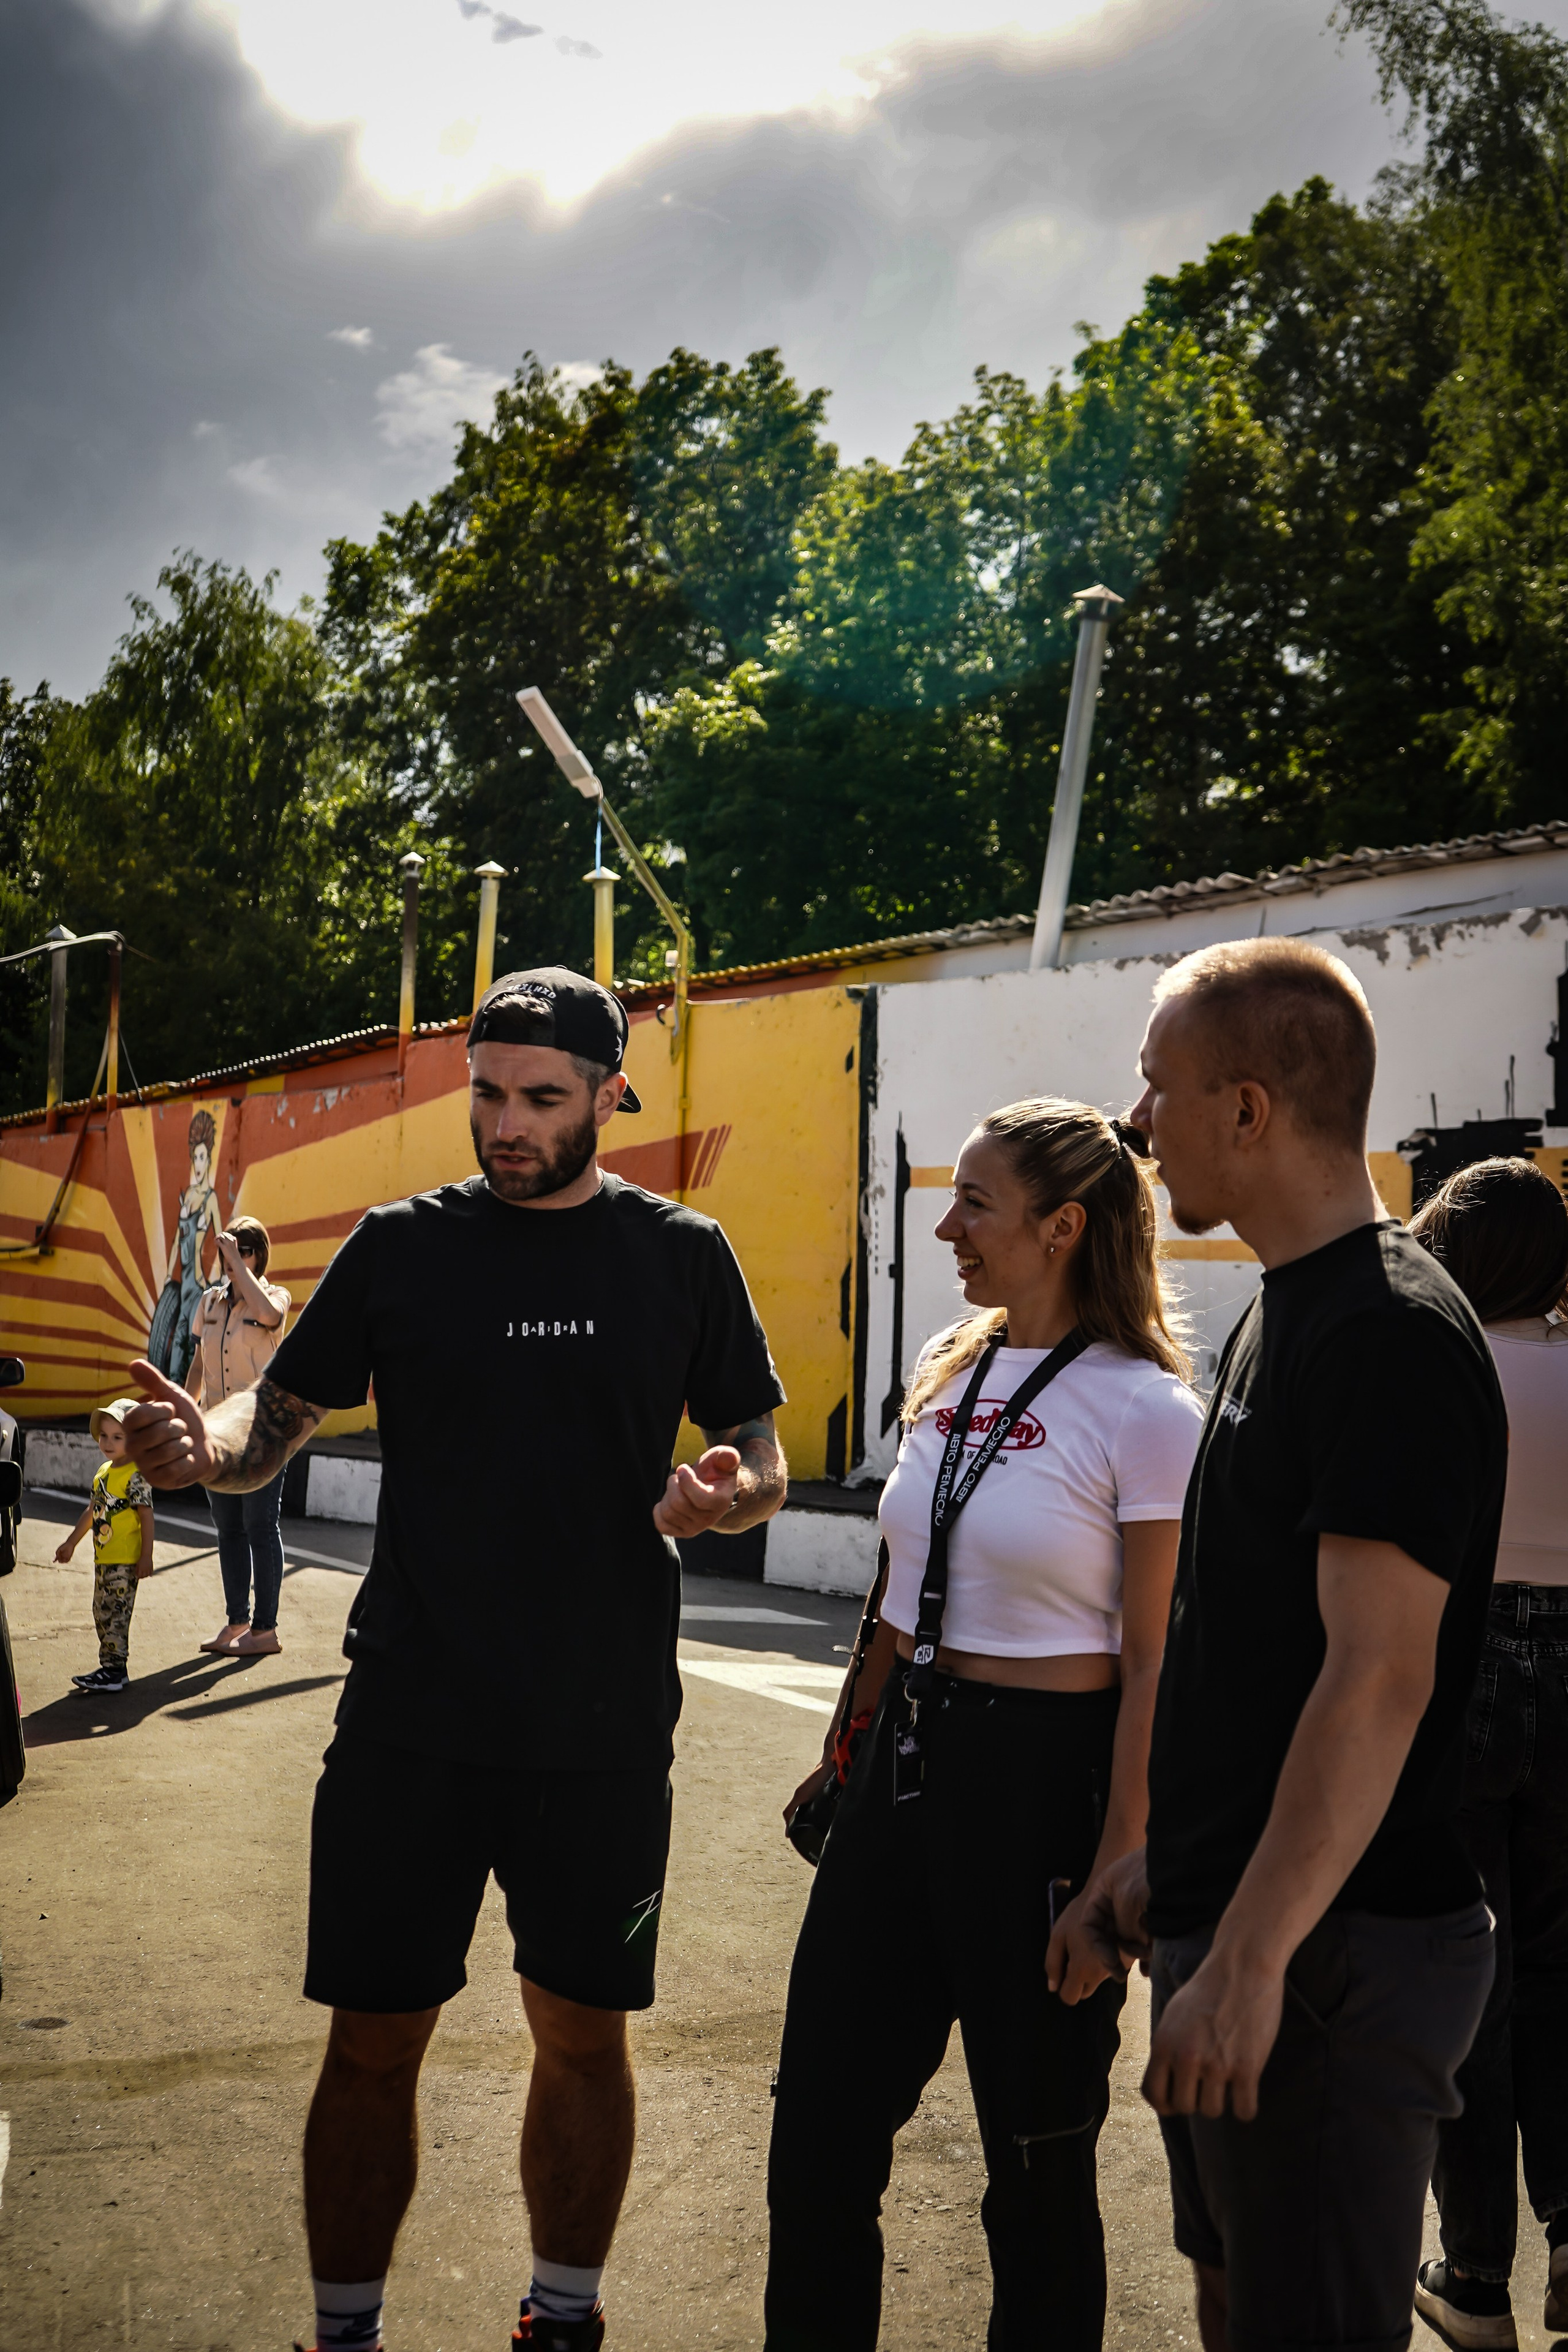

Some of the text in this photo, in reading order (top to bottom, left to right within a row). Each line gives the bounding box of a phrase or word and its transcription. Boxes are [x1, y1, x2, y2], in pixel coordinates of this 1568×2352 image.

[946, 1433, 961, 1463] АВТО
[967, 1450, 976, 1460] OF
[992, 1454, 1008, 1466] OAD
[956, 1472, 975, 1503] АВТО
